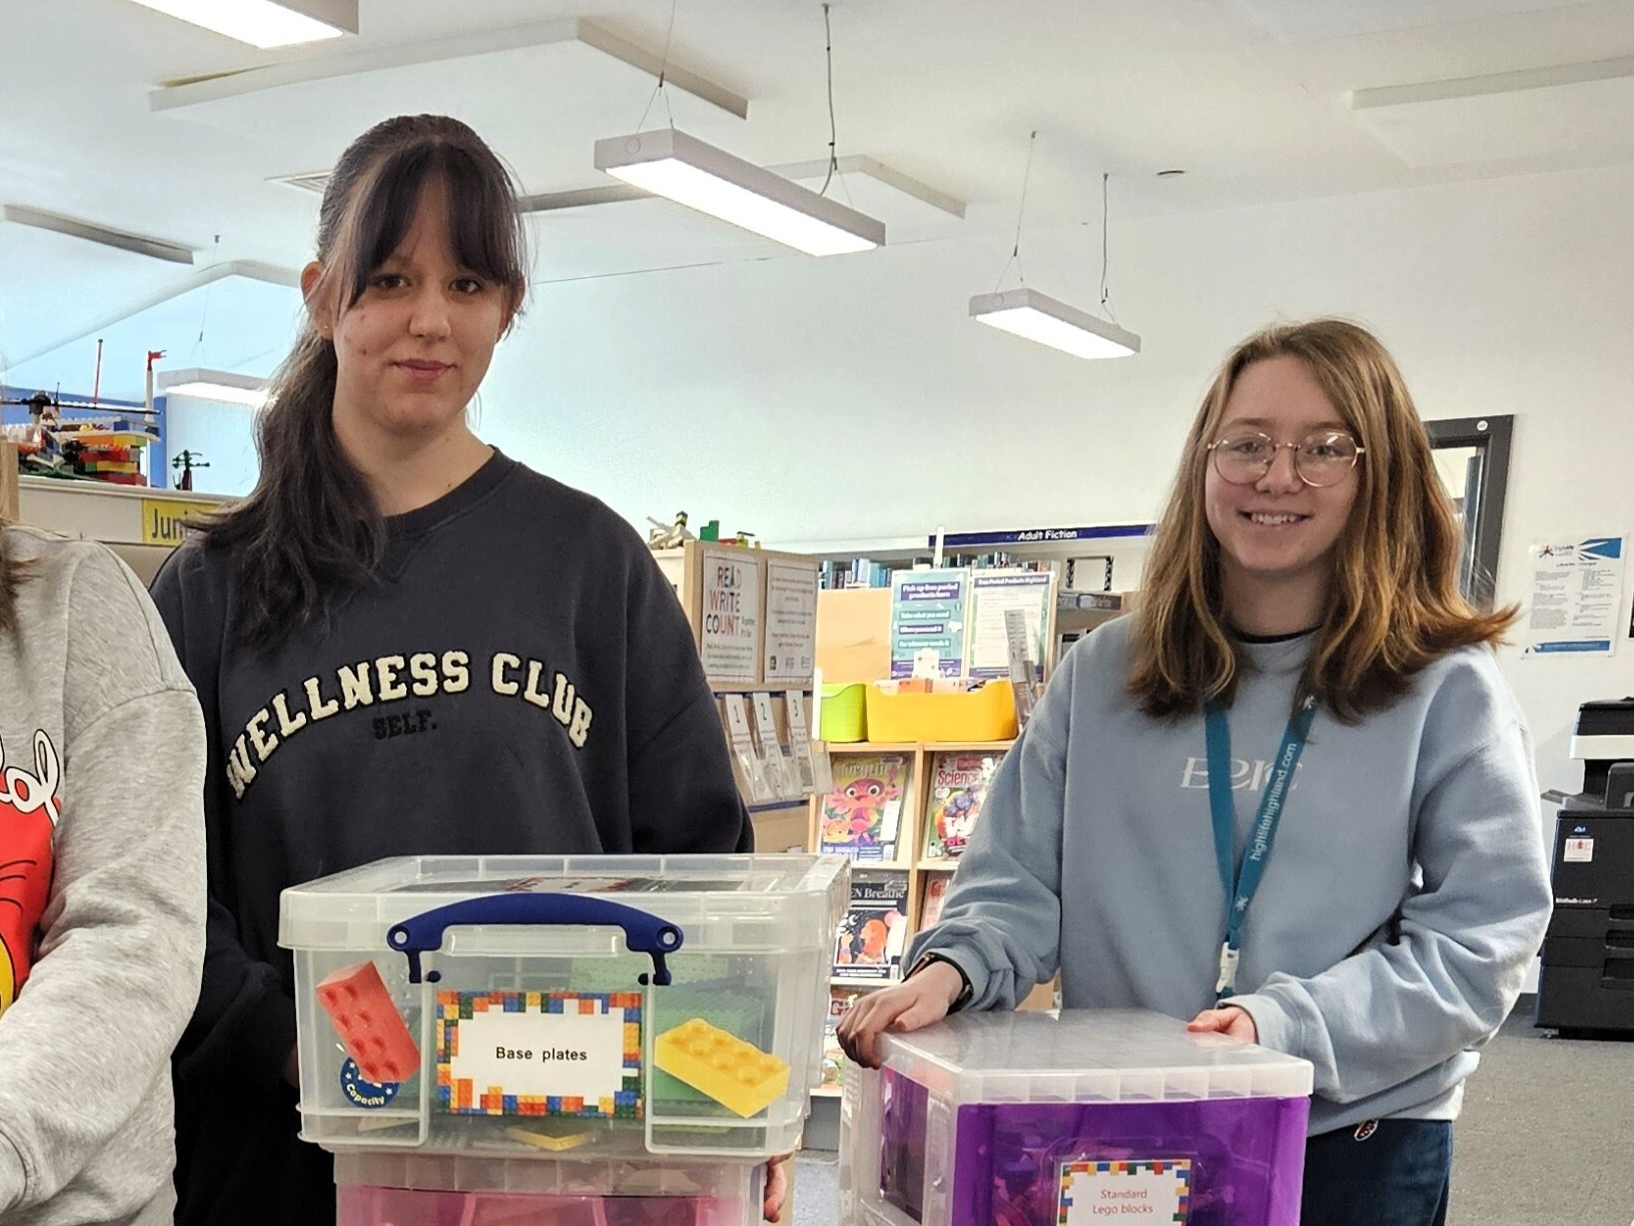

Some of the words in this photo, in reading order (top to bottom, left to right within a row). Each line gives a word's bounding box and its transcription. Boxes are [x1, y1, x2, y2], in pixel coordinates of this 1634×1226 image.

[1018, 531, 1042, 540] Adult
[1045, 530, 1077, 539] Fiction
[717, 566, 741, 589] READ
[710, 590, 740, 612] WRITE
[706, 614, 740, 636] COUNT
[226, 650, 470, 799] WELLNESS
[491, 652, 593, 748] CLUB
[495, 1046, 533, 1062] Base
[542, 1046, 588, 1063] plates
[347, 1084, 384, 1105] Capacity
[1101, 1190, 1147, 1199] Standard
[1093, 1204, 1118, 1216] Lego
[1121, 1204, 1153, 1213] blocks
